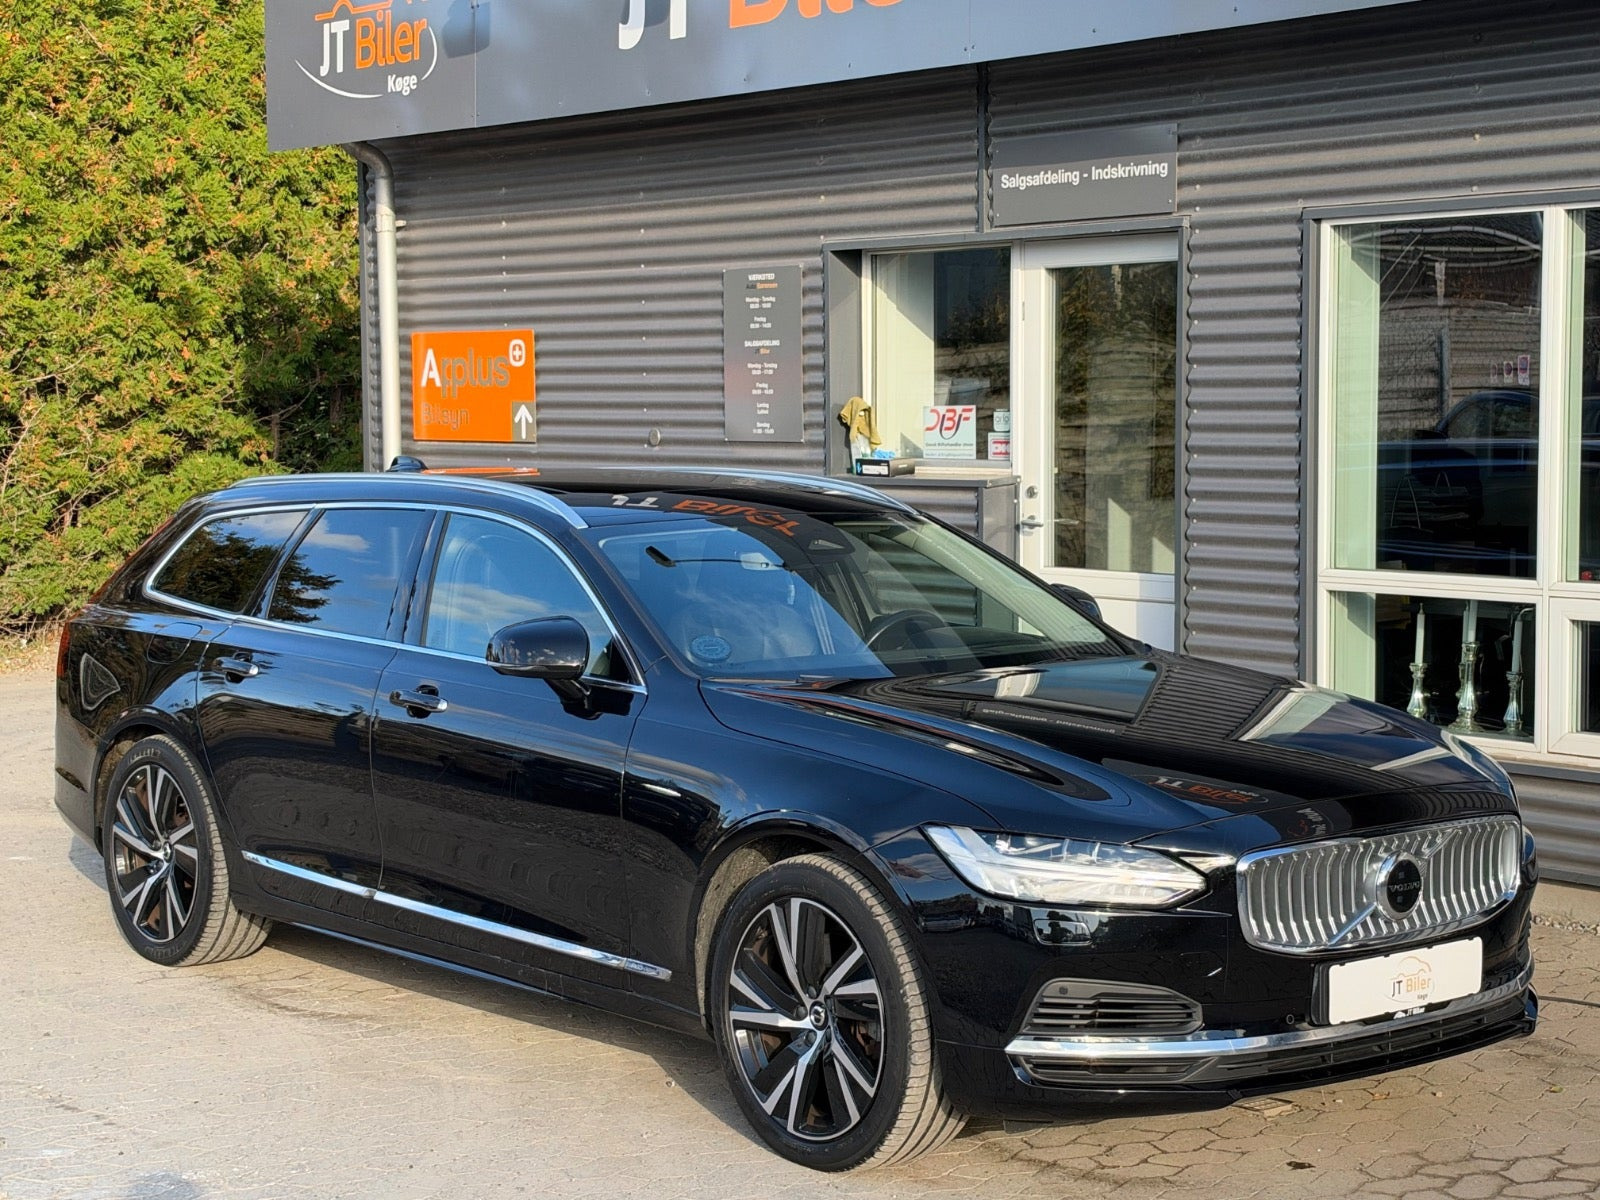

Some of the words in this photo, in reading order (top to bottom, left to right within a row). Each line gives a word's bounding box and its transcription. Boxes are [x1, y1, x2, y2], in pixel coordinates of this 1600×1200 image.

[320, 20, 349, 77] JT
[355, 9, 427, 69] Biler
[387, 74, 418, 96] Køge
[1001, 169, 1080, 190] Salgsafdeling
[1091, 160, 1168, 181] Indskrivning
[1389, 881, 1420, 893] VOLVO
[1391, 980, 1403, 998] JT
[1406, 976, 1431, 993] Biler
